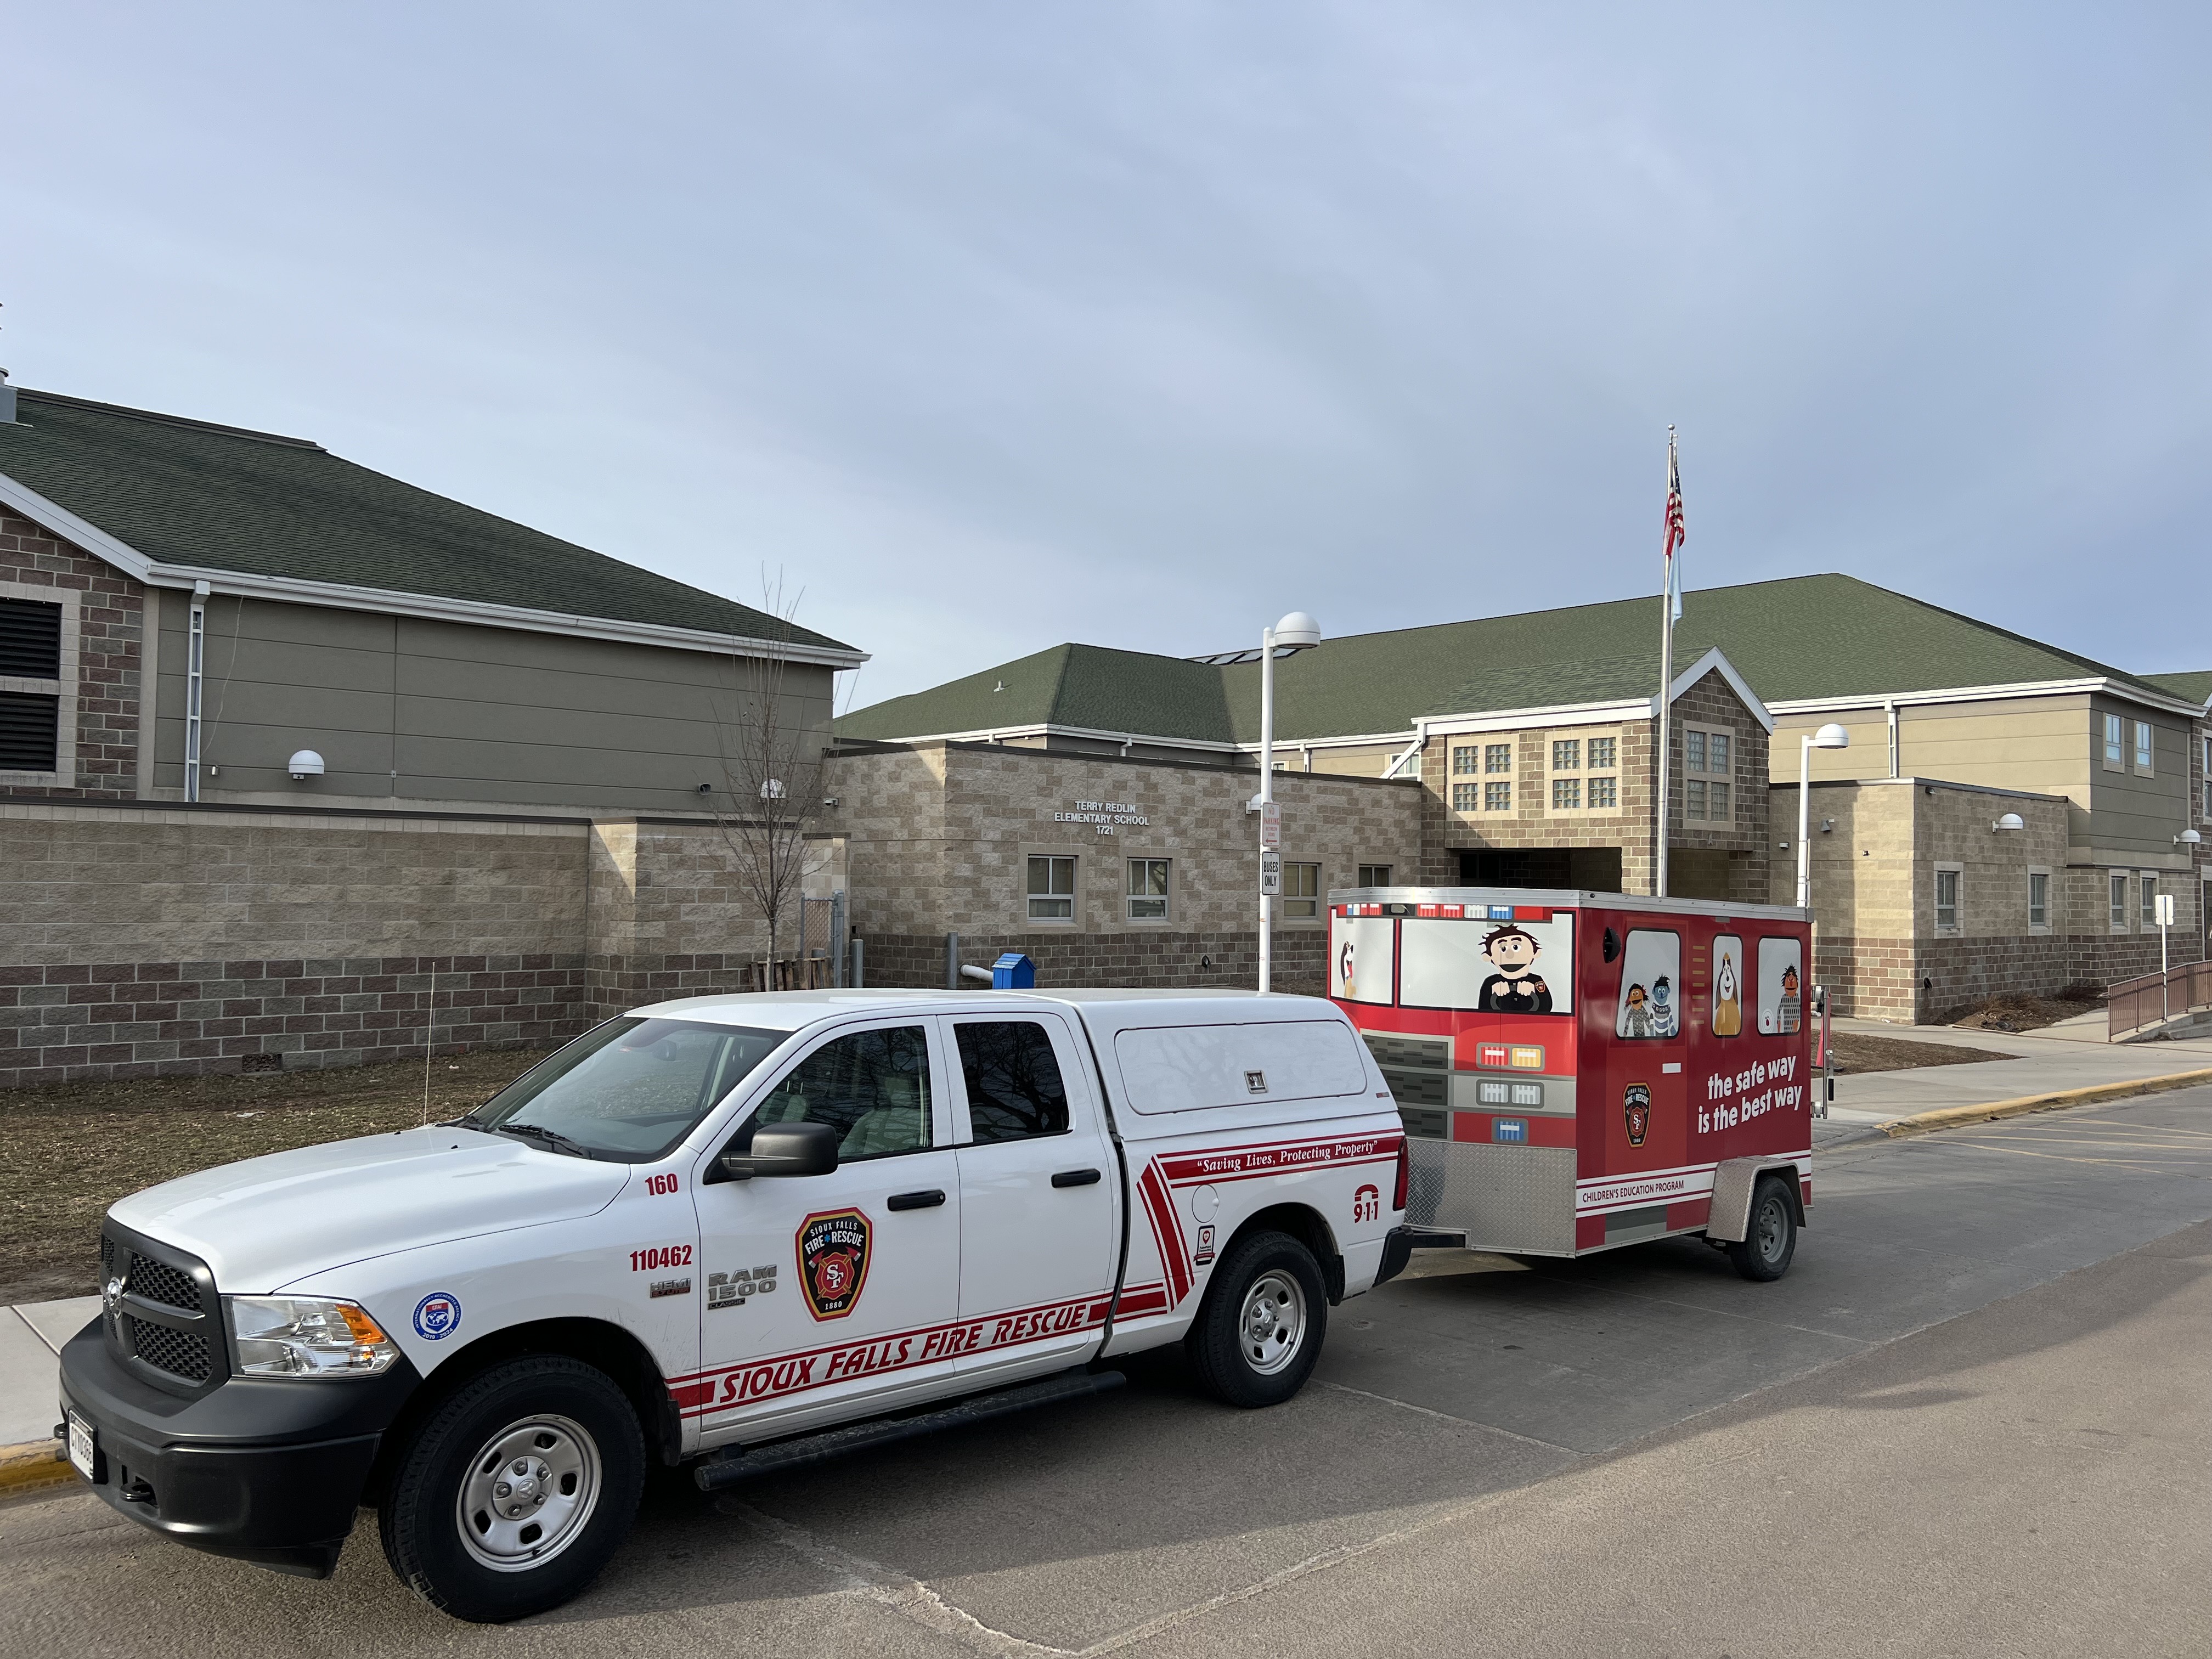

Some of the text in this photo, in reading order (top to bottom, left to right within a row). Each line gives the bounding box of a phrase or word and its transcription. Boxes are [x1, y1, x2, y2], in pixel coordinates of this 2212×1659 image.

[1075, 801, 1136, 813] TERRY REDLIN
[1054, 812, 1150, 826] ELEMENTARY SCHOOL
[1096, 825, 1113, 835] 1721
[1264, 861, 1278, 873] BUSES
[1265, 876, 1277, 887] ONLY
[1708, 1056, 1796, 1100] the safe way
[1625, 1093, 1649, 1107] FIRE RESCUE
[1699, 1086, 1802, 1133] is the best way
[1246, 1154, 1276, 1167] Lives,
[1280, 1146, 1330, 1163] Protecting
[645, 1173, 679, 1196] 160
[1583, 1180, 1684, 1203] CHILDREN'S EDUCATION PROGRAM
[810, 1221, 857, 1237] SIOUX FALLS
[804, 1231, 864, 1255] FIRE RESCUE
[630, 1245, 692, 1271] 110462
[709, 1264, 777, 1286] RAM
[651, 1278, 691, 1290] HEMI
[708, 1279, 776, 1301] 1500
[435, 1294, 456, 1305] ACCREDITED
[710, 1299, 744, 1309] CLASSIC
[825, 1301, 842, 1310] 1880
[439, 1328, 453, 1338] 2024
[720, 1304, 1086, 1403] SIOUX FALLS FIRE RESCUE
